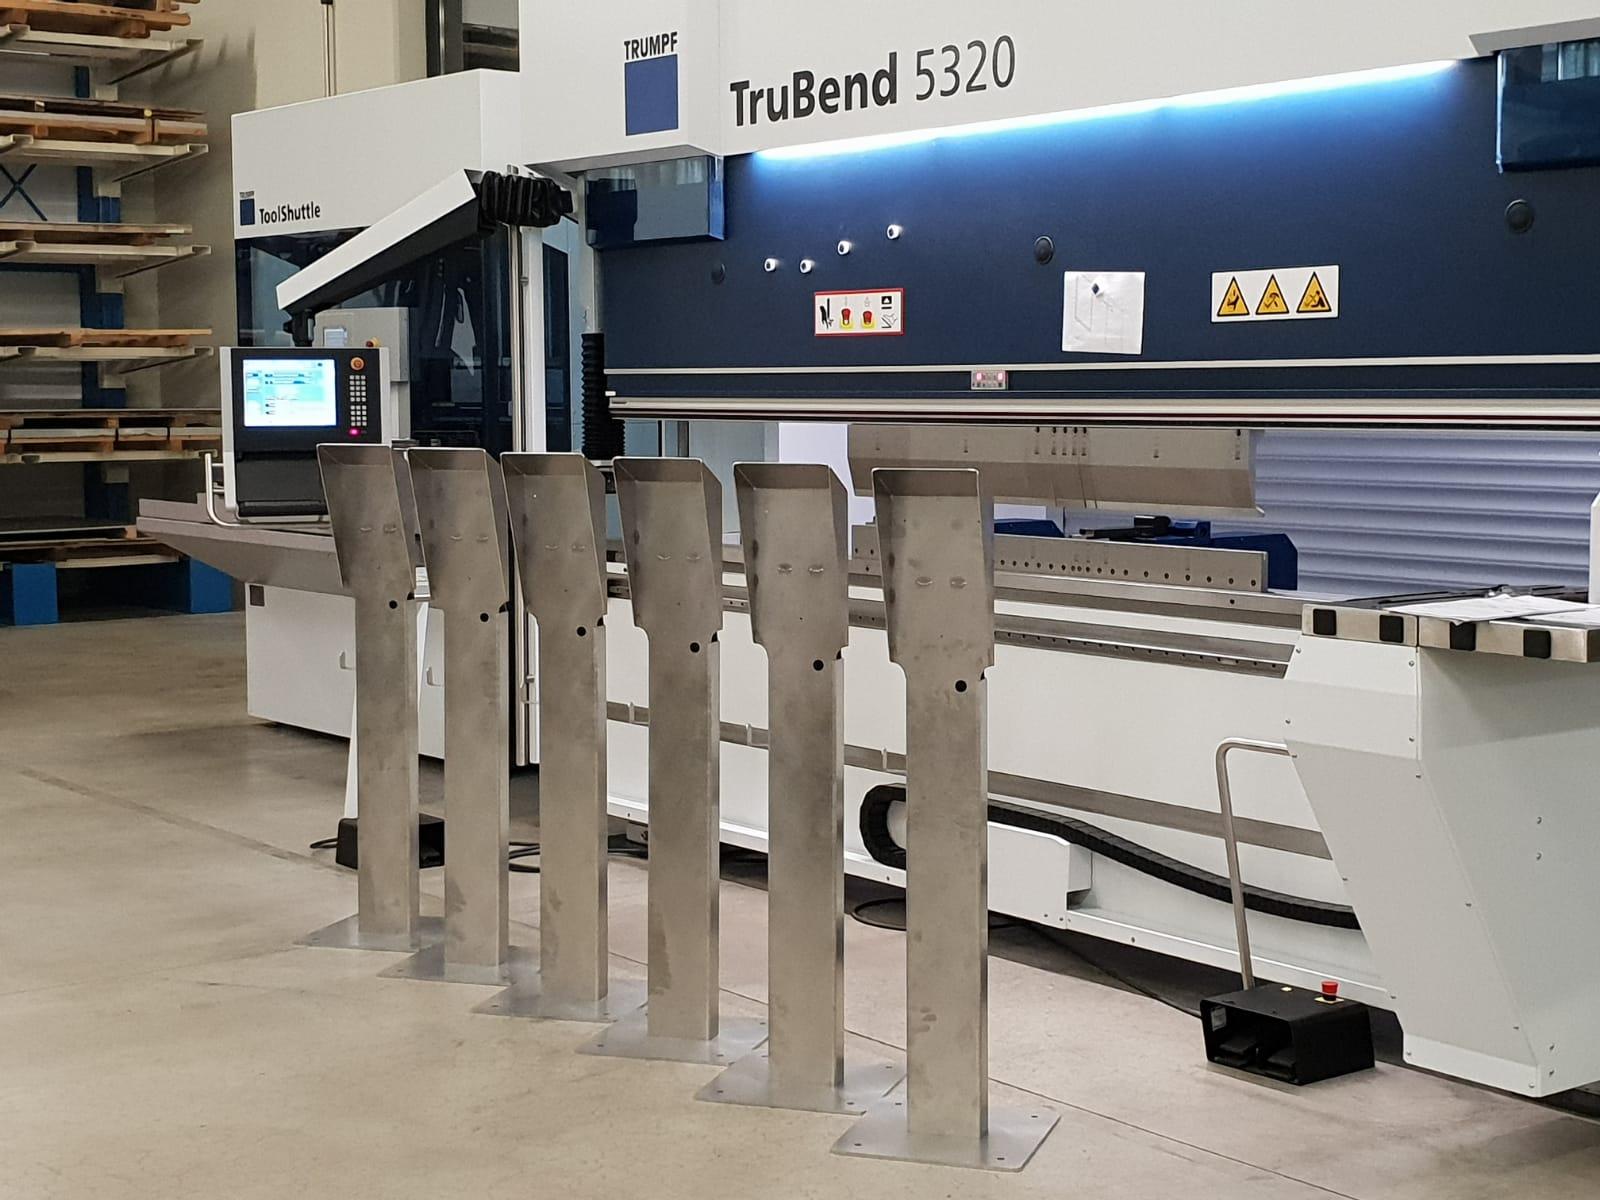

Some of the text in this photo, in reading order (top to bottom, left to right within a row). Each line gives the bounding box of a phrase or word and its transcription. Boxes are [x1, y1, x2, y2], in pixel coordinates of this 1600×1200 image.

[624, 31, 678, 61] TRUMPF
[730, 35, 1015, 127] TruBend 5320
[259, 200, 321, 225] ToolShuttle
